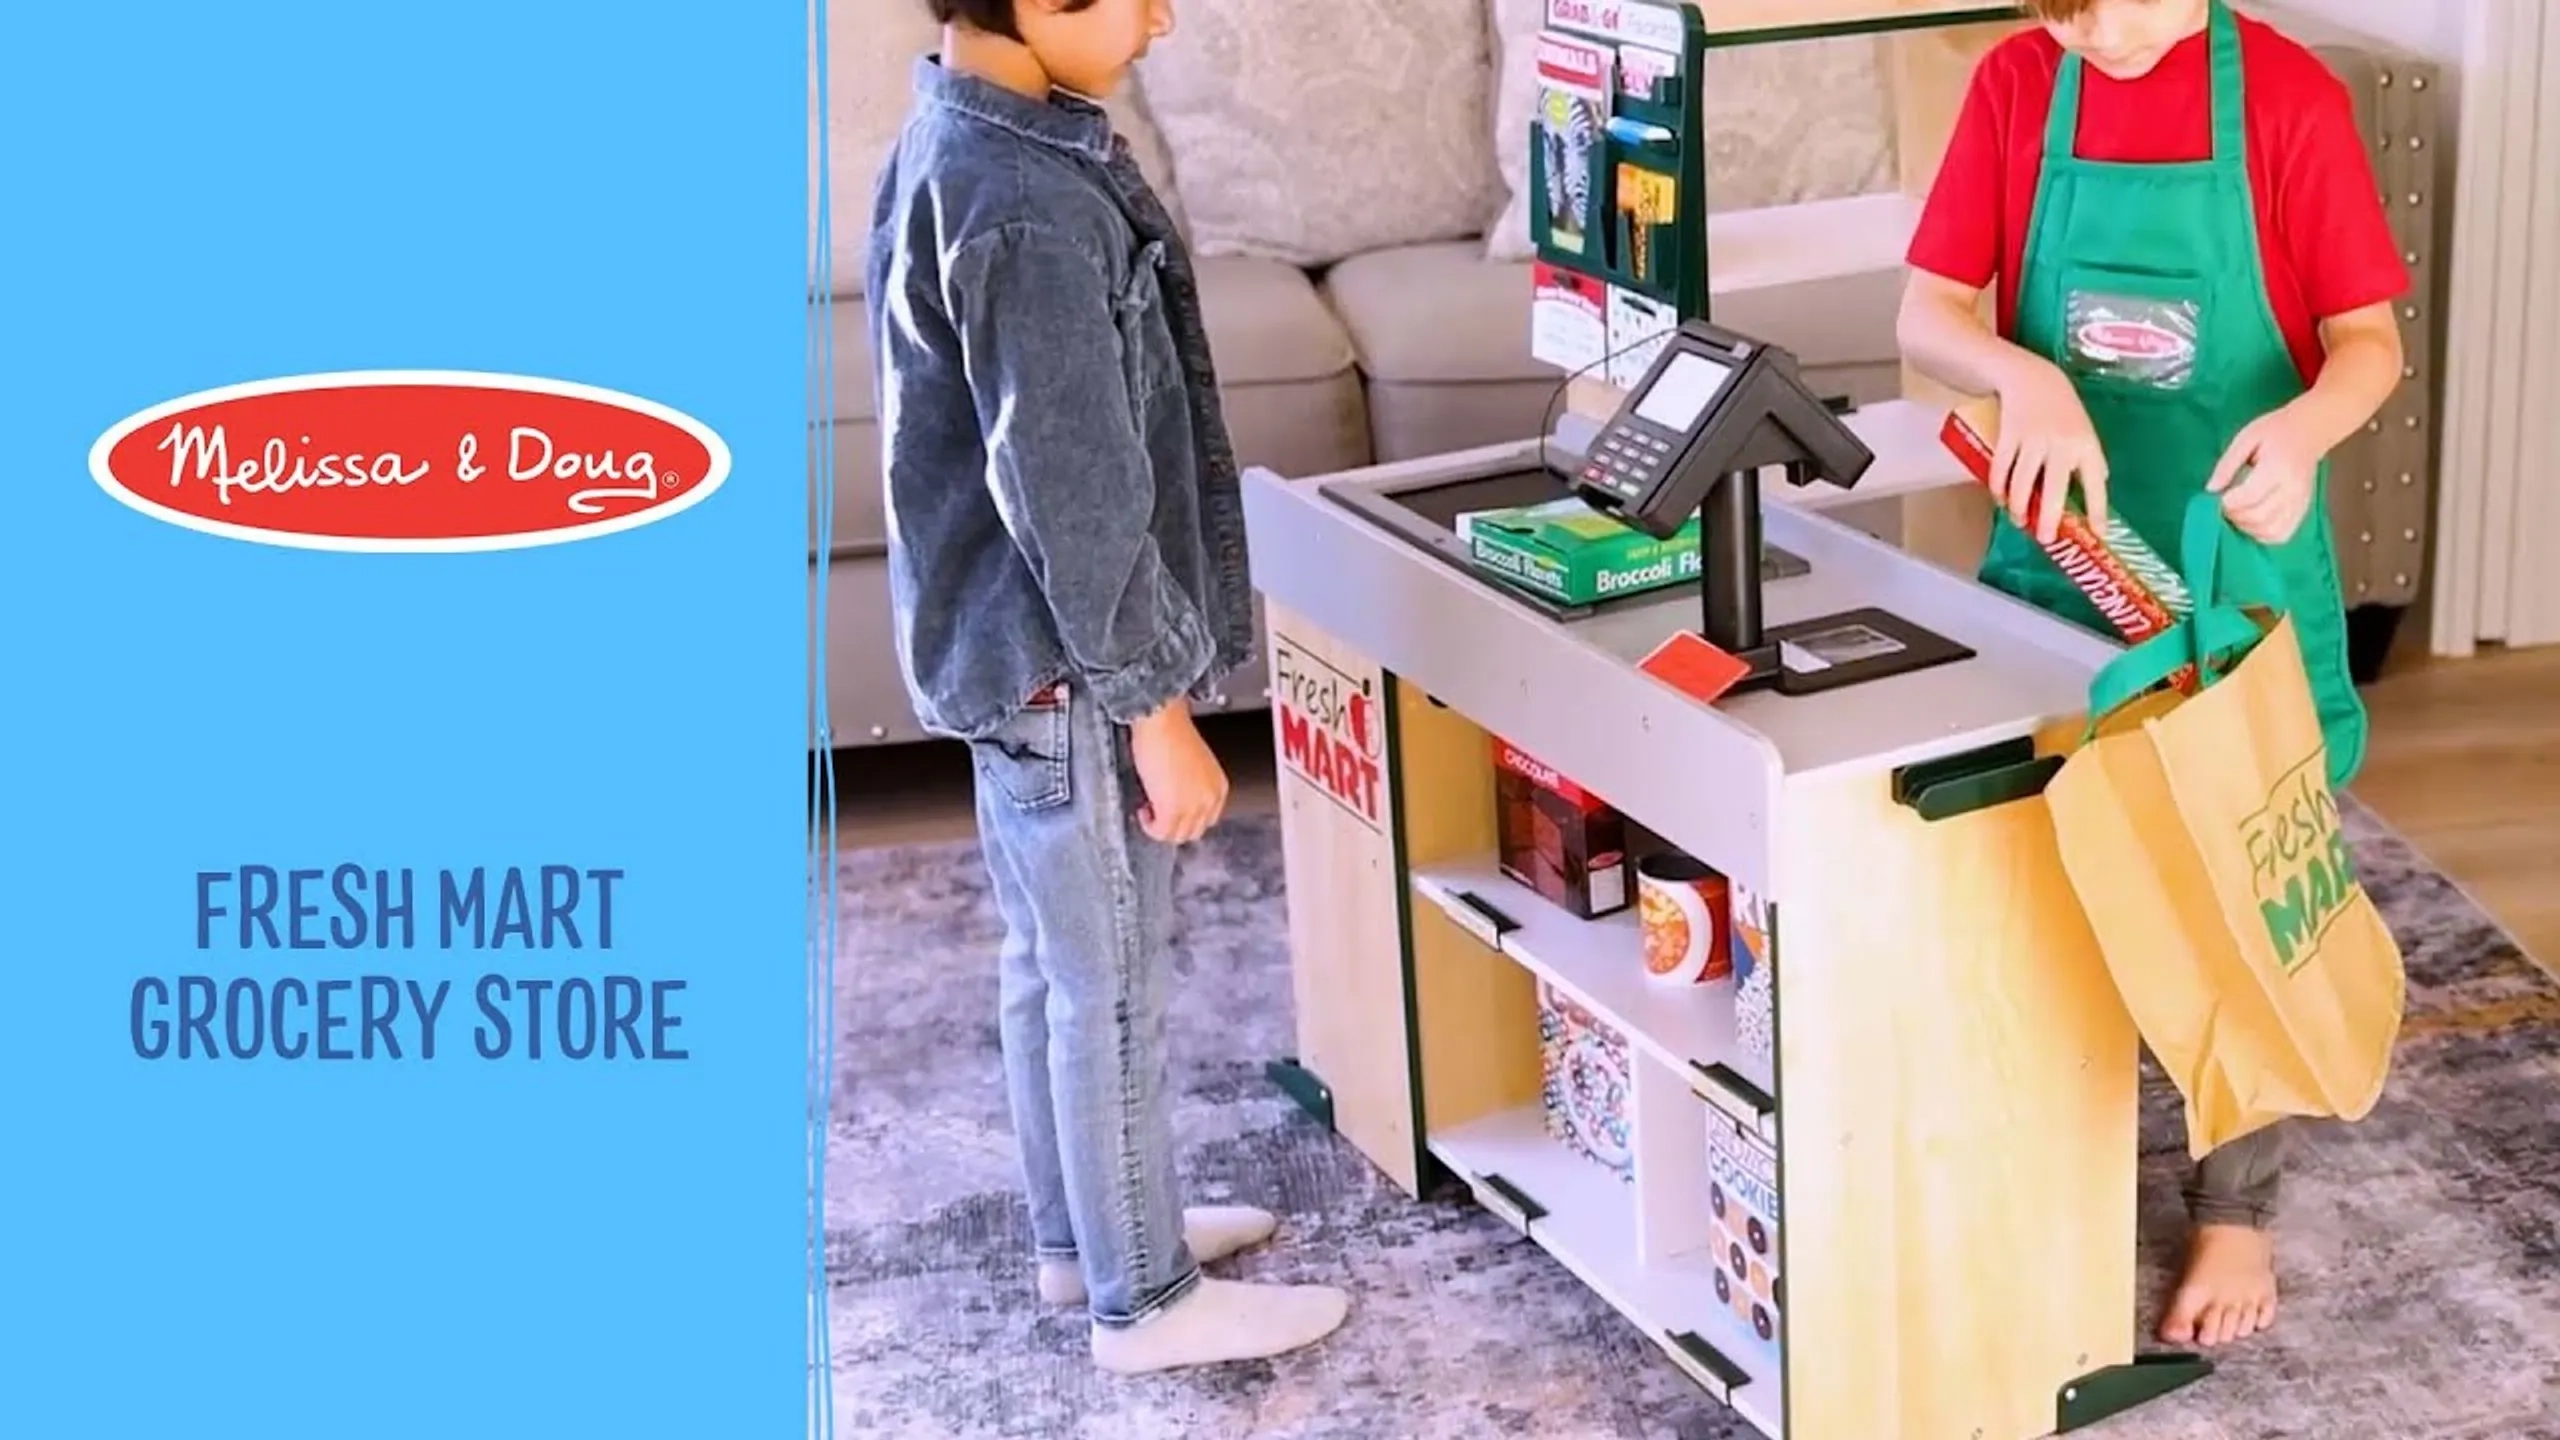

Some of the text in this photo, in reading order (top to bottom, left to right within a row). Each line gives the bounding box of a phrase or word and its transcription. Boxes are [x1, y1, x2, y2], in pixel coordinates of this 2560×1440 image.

[1596, 560, 1673, 593] Broccoli
[2045, 537, 2152, 635] LINGUINI
[1277, 648, 1351, 738] Fresh
[1281, 703, 1379, 822] MART
[2246, 772, 2338, 898] Fresh
